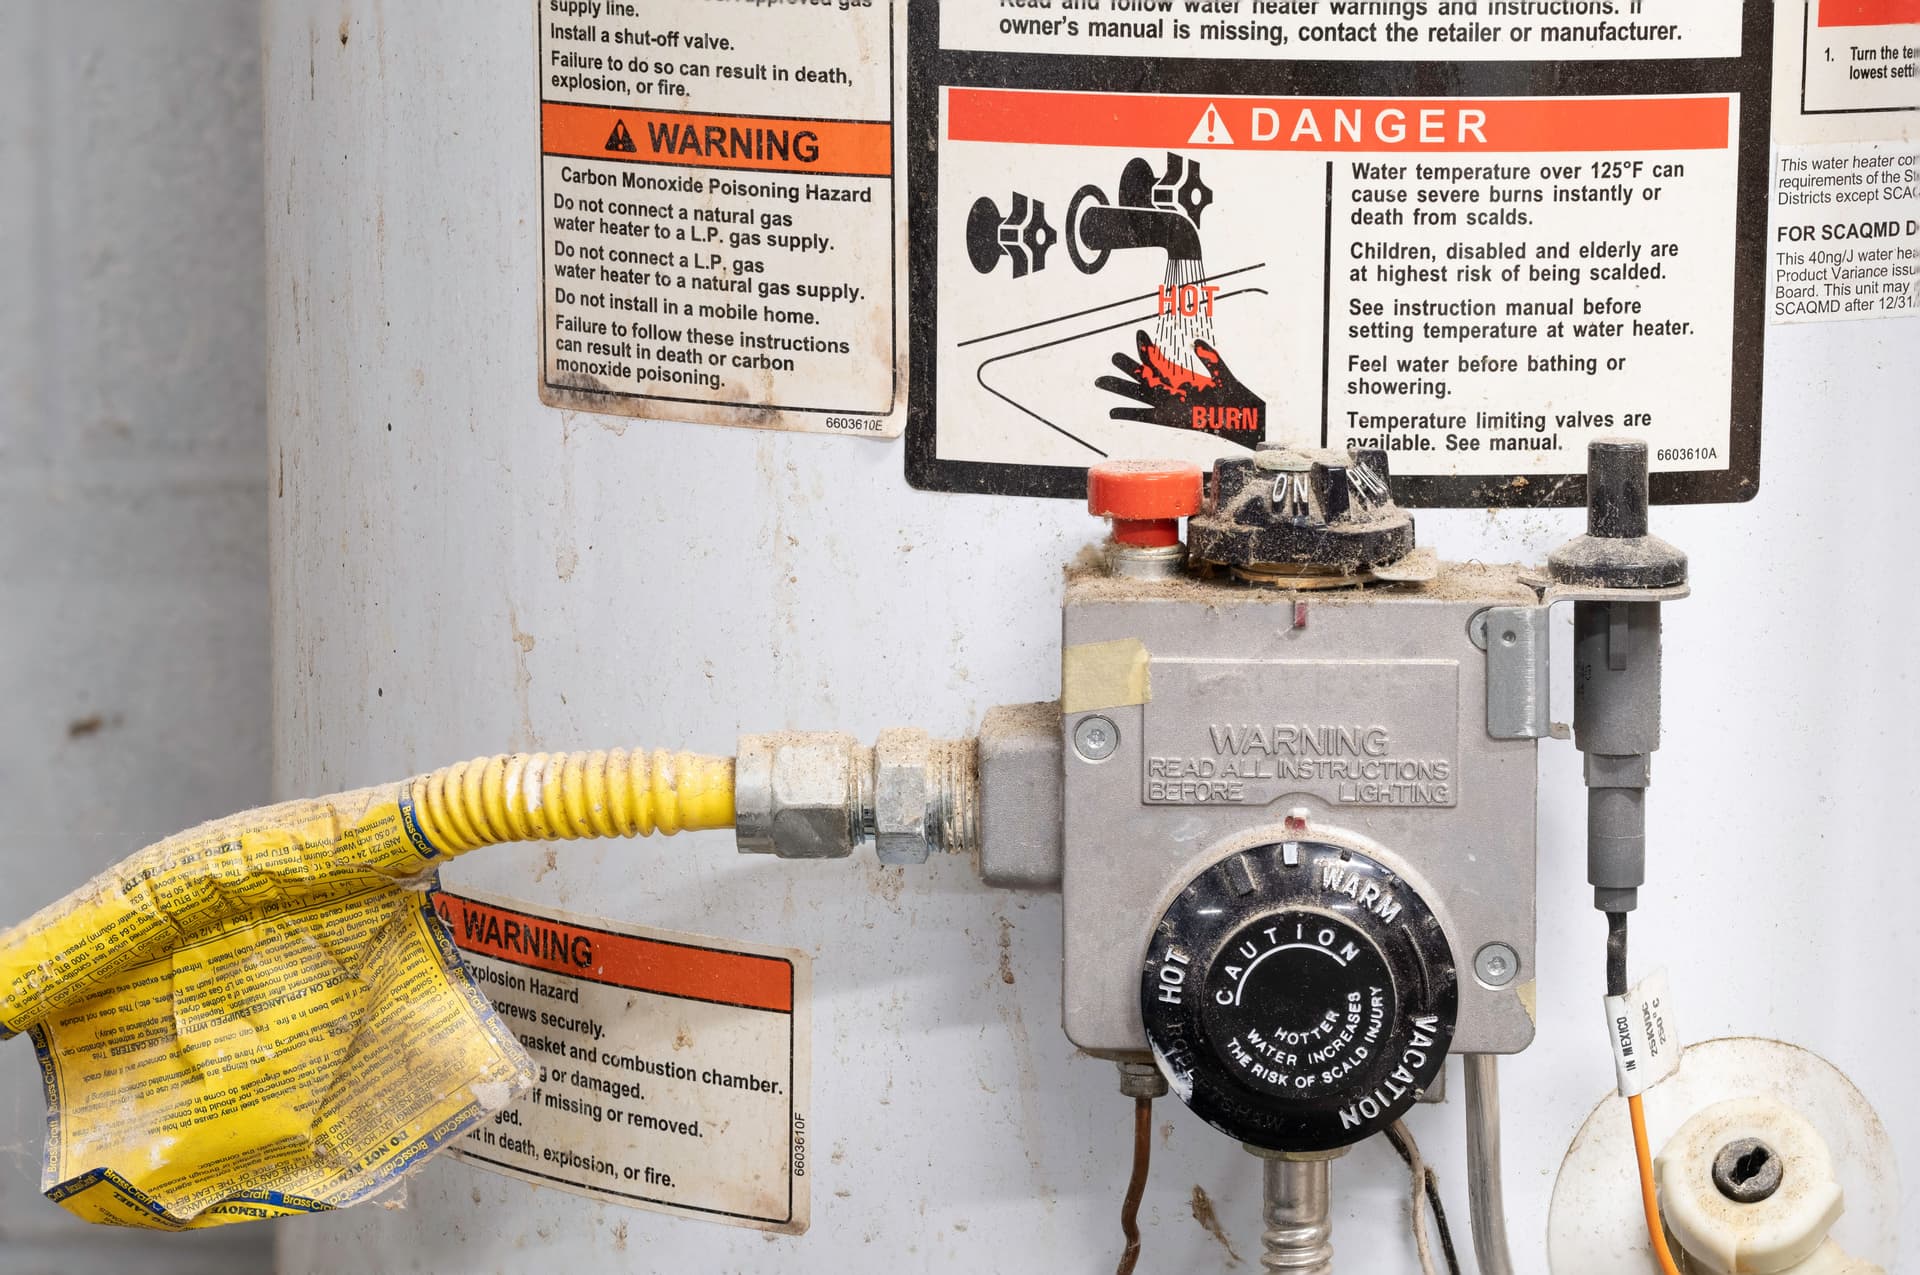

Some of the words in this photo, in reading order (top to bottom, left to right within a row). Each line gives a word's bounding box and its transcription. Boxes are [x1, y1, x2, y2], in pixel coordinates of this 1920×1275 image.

[550, 0, 601, 19] supply
[606, 0, 639, 17] line.
[551, 22, 596, 42] Install
[601, 30, 609, 43] a
[615, 28, 679, 47] shut-off
[683, 33, 734, 51] valve.
[1089, 18, 1163, 38] manual
[1174, 19, 1190, 39] is
[1200, 20, 1288, 46] missing,
[1298, 22, 1377, 42] contact
[1385, 22, 1418, 42] the
[1428, 22, 1501, 42] retailer
[1510, 27, 1532, 42] or
[1541, 21, 1681, 42] manufacturer.
[1825, 47, 1834, 62] 1.
[1850, 46, 1877, 61] Turn
[1880, 45, 1899, 60] the
[552, 50, 603, 70] Failure
[607, 56, 623, 71] to
[628, 56, 649, 73] do
[654, 62, 674, 75] so
[680, 64, 710, 77] can
[716, 64, 767, 80] result
[773, 65, 788, 81] in
[795, 66, 852, 87] death,
[1849, 65, 1888, 80] lowest
[551, 73, 630, 96] explosion,
[636, 81, 653, 94] or
[657, 79, 690, 97] fire.
[1251, 106, 1489, 144] DANGER
[648, 121, 819, 163] WARNING
[1352, 162, 1407, 180] Water
[1416, 163, 1530, 184] temperature
[1540, 166, 1582, 179] over
[1591, 161, 1643, 179] 125°F
[1653, 164, 1684, 178] can
[1781, 158, 1807, 172] This
[1812, 157, 1849, 170] water
[1853, 155, 1895, 168] heater
[561, 166, 617, 187] Carbon
[622, 171, 703, 193] Monoxide
[709, 178, 799, 203] Poisoning
[806, 184, 871, 202] Hazard
[1779, 173, 1863, 191] requirements
[1866, 170, 1879, 184] of
[1881, 170, 1901, 184] the
[1352, 189, 1407, 203] cause
[1417, 190, 1479, 203] severe
[1490, 185, 1543, 202] burns
[1553, 184, 1633, 206] instantly
[1642, 187, 1662, 201] or
[1778, 190, 1831, 205] Districts
[1836, 188, 1879, 204] except
[1351, 208, 1403, 225] death
[1413, 208, 1457, 225] from
[1466, 208, 1533, 225] scalds.
[1778, 225, 1815, 242] FOR
[1821, 221, 1900, 240] SCAQMD
[1777, 268, 1827, 282] Product
[1831, 265, 1888, 280] Variance
[1158, 284, 1220, 317] HOT
[1776, 284, 1819, 299] Board.
[1824, 283, 1851, 296] This
[1855, 281, 1879, 295] unit
[1883, 282, 1910, 295] may
[555, 287, 575, 304] Do
[580, 293, 605, 308] not
[610, 293, 657, 313] install
[663, 298, 678, 315] in
[684, 304, 693, 316] a
[699, 303, 758, 321] mobile
[764, 306, 819, 325] home.
[1349, 298, 1384, 316] See
[1394, 299, 1495, 316] instruction
[1506, 298, 1573, 316] manual
[1584, 297, 1641, 315] before
[1349, 321, 1413, 343] setting
[1423, 322, 1537, 343] temperature
[1547, 321, 1564, 338] at
[1573, 321, 1624, 337] water
[1633, 319, 1694, 336] heater.
[826, 417, 882, 431] 6603610E
[1192, 406, 1258, 430] BURN
[1347, 411, 1466, 433] Temperature
[1477, 411, 1546, 433] limiting
[1555, 411, 1614, 428] valves
[1623, 413, 1651, 427] are
[1446, 434, 1480, 451] See
[1490, 433, 1562, 451] manual.
[1657, 447, 1717, 461] 6603610A
[1272, 472, 1309, 503] ON
[1209, 723, 1390, 757] WARNING
[1149, 757, 1215, 777] READ
[1225, 759, 1273, 779] ALL
[1278, 759, 1450, 780] INSTRUCTIONS
[1149, 782, 1244, 801] BEFORE
[1338, 783, 1449, 804] LIGHTING
[402, 806, 431, 857] BrassCraft
[1319, 863, 1402, 924] WARM
[462, 907, 593, 969] WARNING
[1158, 946, 1191, 1005] HOT
[1216, 926, 1361, 1006] CAUTION
[530, 977, 578, 1004] Hazard
[491, 999, 537, 1023] screws
[541, 1014, 605, 1040] securely.
[1247, 1029, 1298, 1066] WATER
[1308, 990, 1361, 1065] INCREASES
[1275, 1009, 1340, 1046] HOTTER
[1227, 1036, 1255, 1069] THE
[1254, 1062, 1288, 1088] RISK
[1295, 1073, 1316, 1089] OF
[1322, 1044, 1370, 1085] SCALD
[1366, 986, 1384, 1044] INJURY
[1617, 1016, 1634, 1056] MEXICO
[519, 1033, 566, 1056] gasket
[570, 1046, 597, 1063] and
[601, 1053, 696, 1082] combustion
[702, 1069, 783, 1095] chamber.
[1338, 1015, 1440, 1131] VACATION
[1625, 1060, 1636, 1071] IN
[552, 1069, 567, 1083] or
[571, 1068, 646, 1101] damaged.
[533, 1087, 542, 1104] if
[545, 1093, 602, 1122] missing
[607, 1109, 623, 1122] or
[628, 1112, 703, 1138] removed.
[363, 1145, 388, 1166] NOT
[380, 1140, 429, 1176] BrassCraft
[484, 1127, 495, 1145] in
[499, 1133, 539, 1160] death,
[543, 1149, 619, 1178] explosion,
[624, 1167, 640, 1180] or
[644, 1166, 675, 1188] fire.
[794, 1112, 805, 1176] 6603610F
